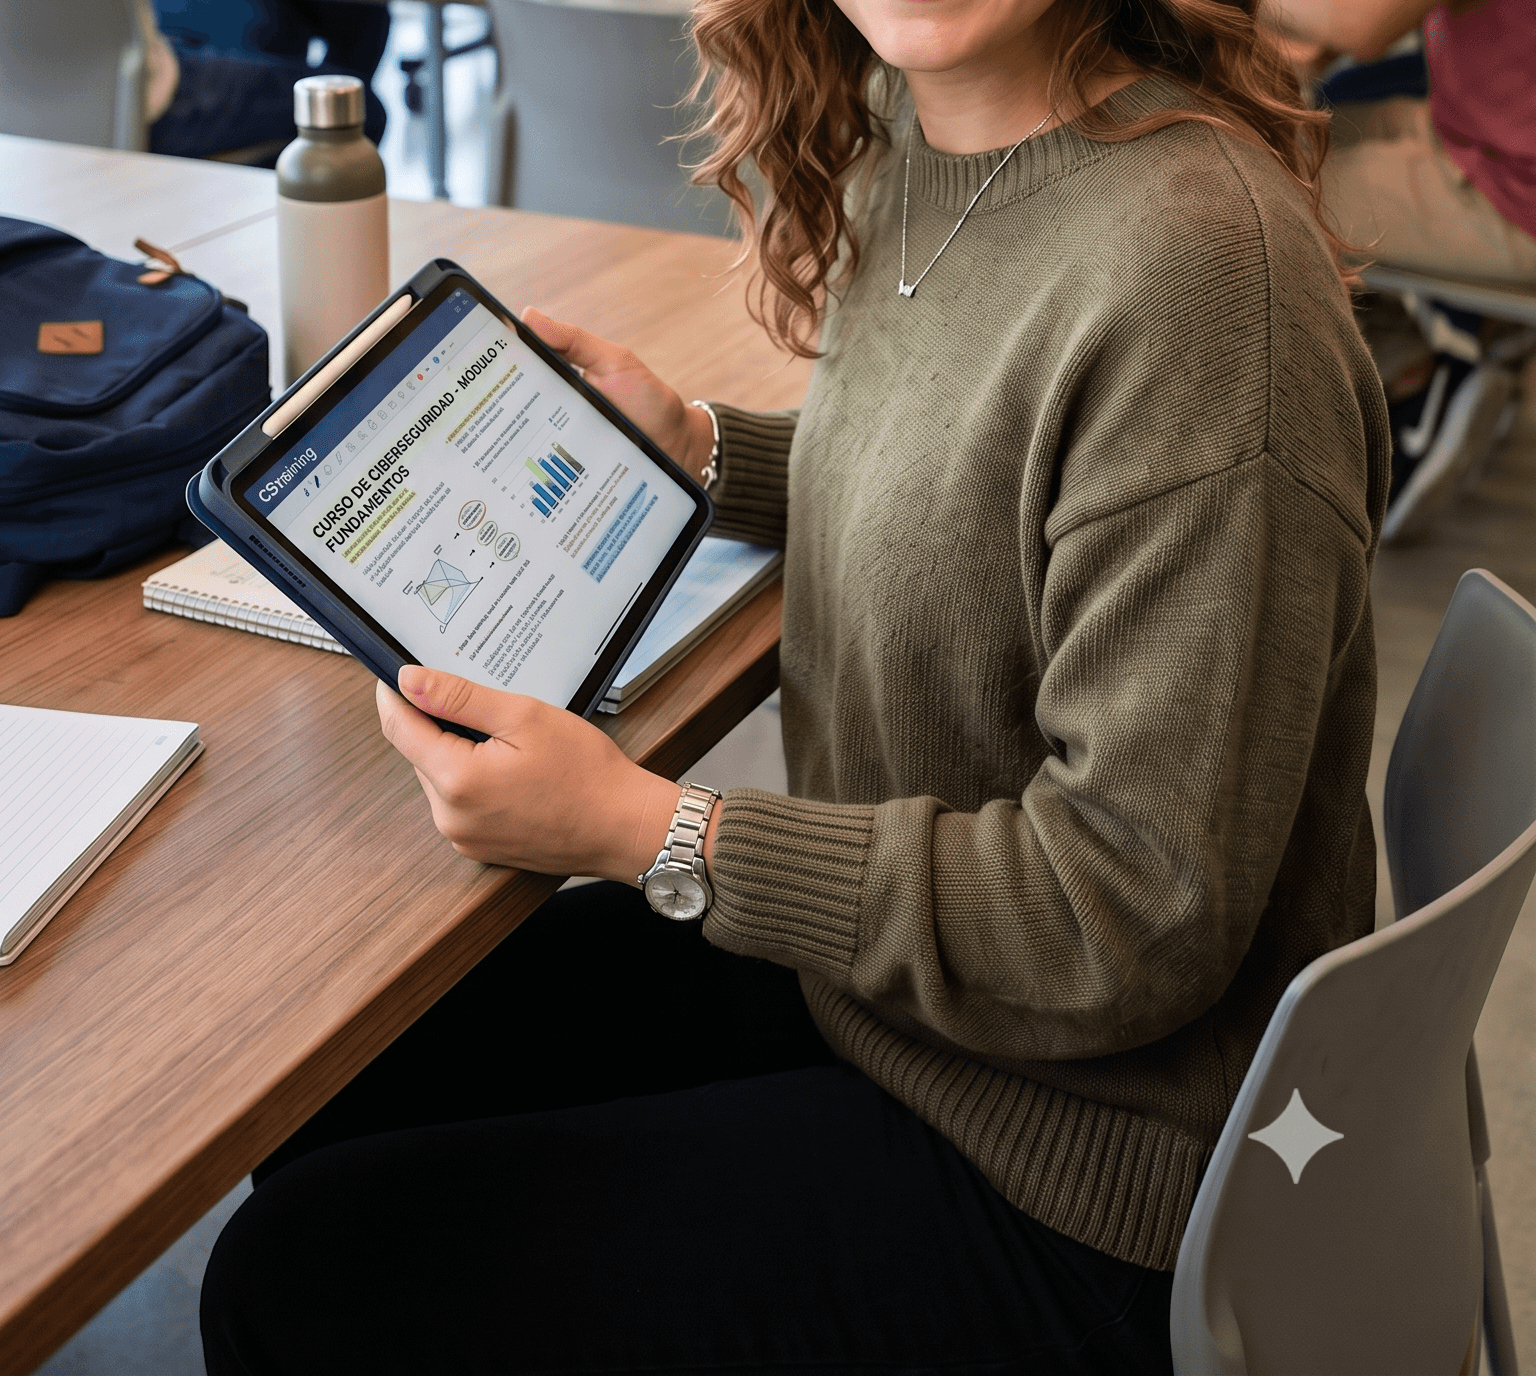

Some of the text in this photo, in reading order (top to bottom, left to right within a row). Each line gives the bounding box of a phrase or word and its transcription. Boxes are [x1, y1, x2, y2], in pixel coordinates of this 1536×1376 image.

[311, 495, 355, 539] CURSO
[350, 477, 373, 500] DE
[367, 392, 455, 481] CIBERSEGURIDAD
[325, 465, 410, 554] FUNDAMENTOS
